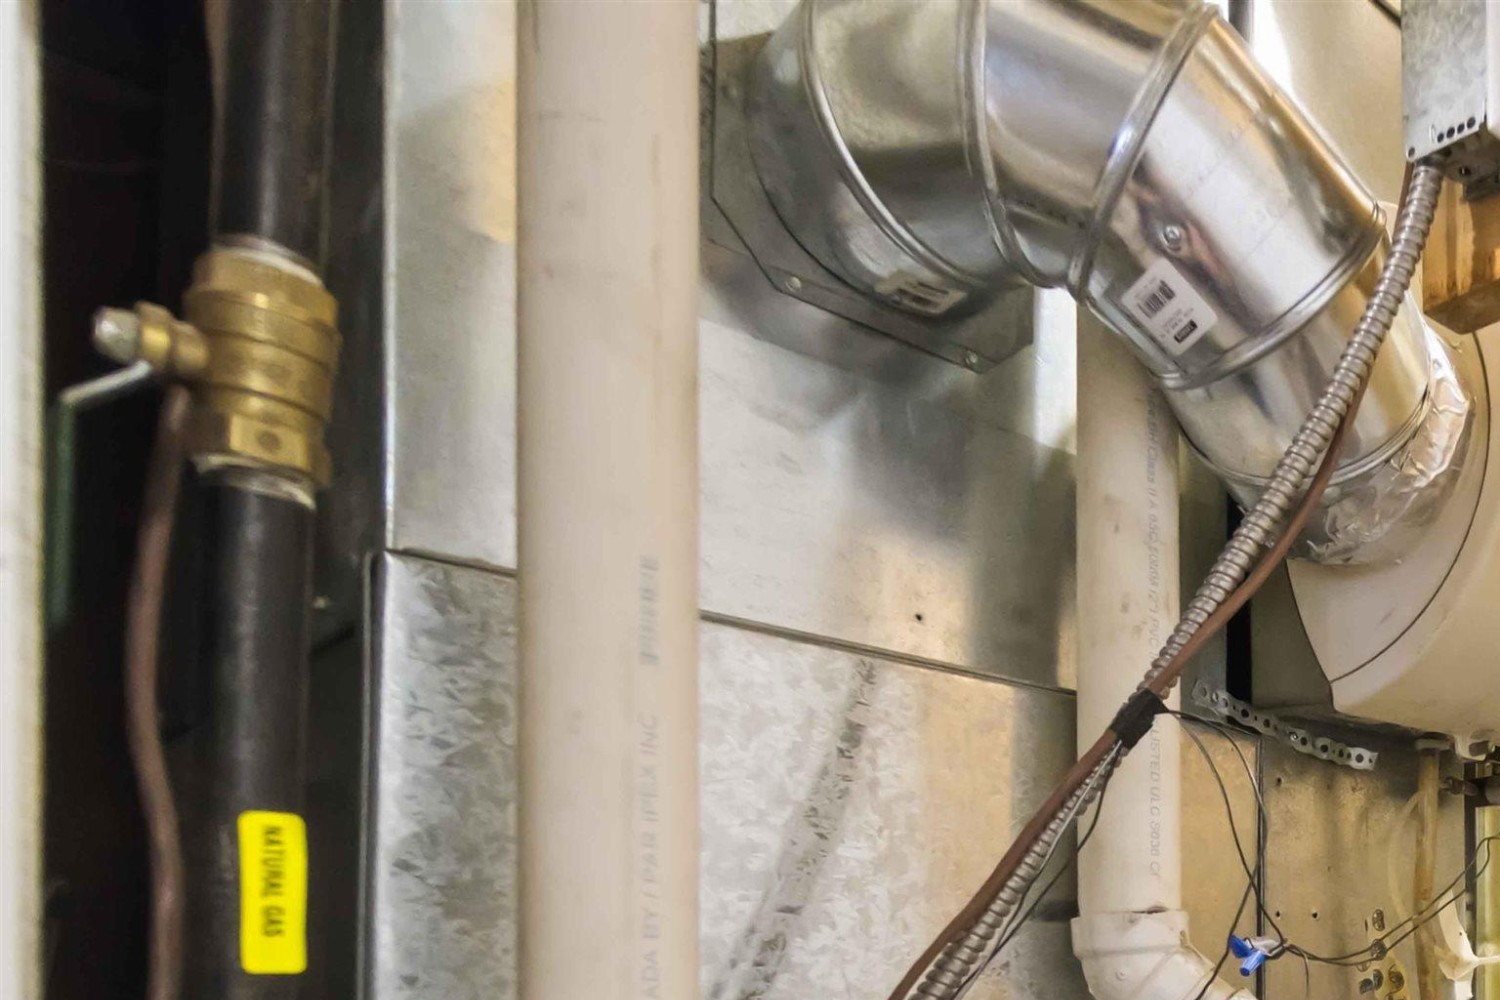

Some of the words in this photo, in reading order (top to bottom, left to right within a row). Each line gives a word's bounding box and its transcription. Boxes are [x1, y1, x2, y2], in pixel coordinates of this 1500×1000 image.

[637, 712, 659, 756] INC
[1149, 729, 1161, 782] LISTED
[261, 826, 285, 897] NATURAL
[260, 905, 286, 938] GAS
